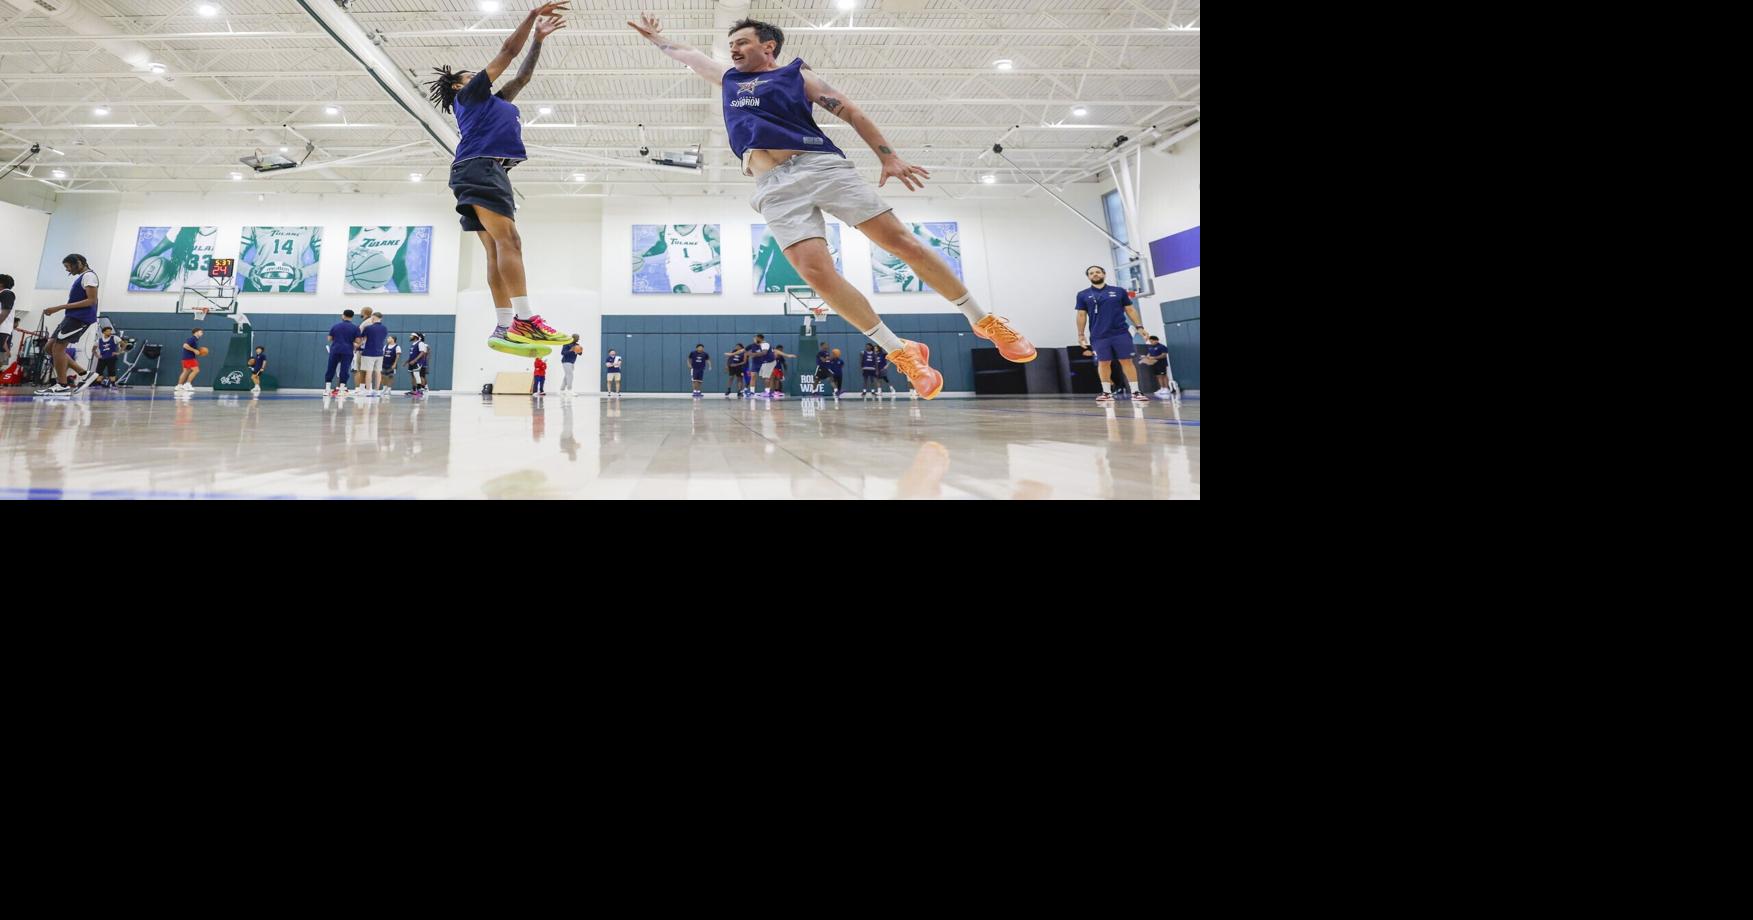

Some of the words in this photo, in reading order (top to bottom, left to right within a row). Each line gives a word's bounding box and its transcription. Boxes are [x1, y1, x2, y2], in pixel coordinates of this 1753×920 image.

[273, 239, 294, 255] 14
[360, 238, 400, 248] TULANE
[683, 248, 689, 258] 1
[212, 265, 227, 275] 24
